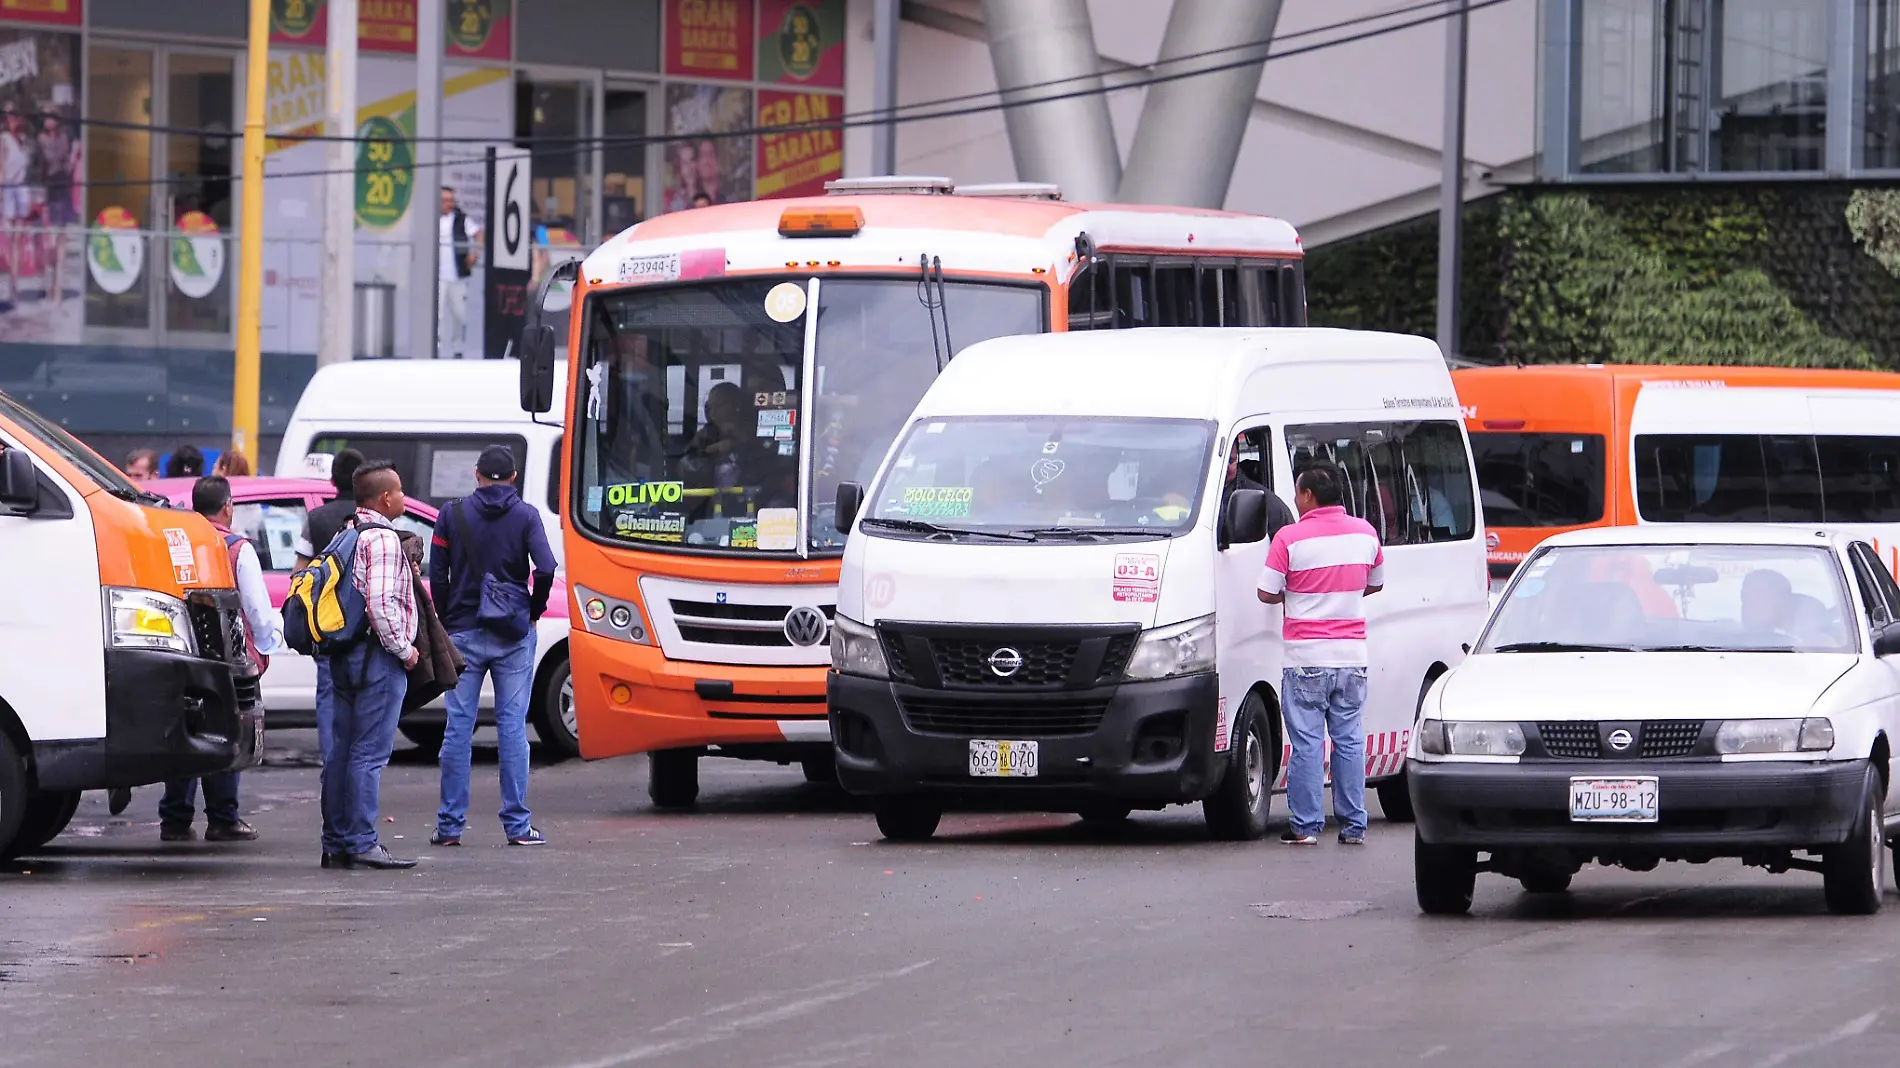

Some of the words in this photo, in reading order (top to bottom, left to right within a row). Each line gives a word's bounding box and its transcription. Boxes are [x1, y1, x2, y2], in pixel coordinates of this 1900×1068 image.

[679, 0, 738, 27] GRAN
[681, 28, 738, 50] BARATA
[268, 51, 327, 97] RAN
[760, 91, 830, 143] GRAN
[368, 138, 393, 161] 50
[765, 127, 834, 171] BARATA
[503, 161, 521, 256] 6
[619, 259, 677, 276] A-23944-E
[773, 292, 797, 313] 05
[608, 482, 682, 506] OLIVO
[615, 512, 686, 533] Chamizal
[180, 569, 191, 581] 87
[1117, 565, 1155, 577] 03-A
[871, 580, 889, 602] 10
[972, 750, 998, 767] 669
[1009, 751, 1035, 768] 070
[1575, 791, 1655, 810] MZU-98-12
